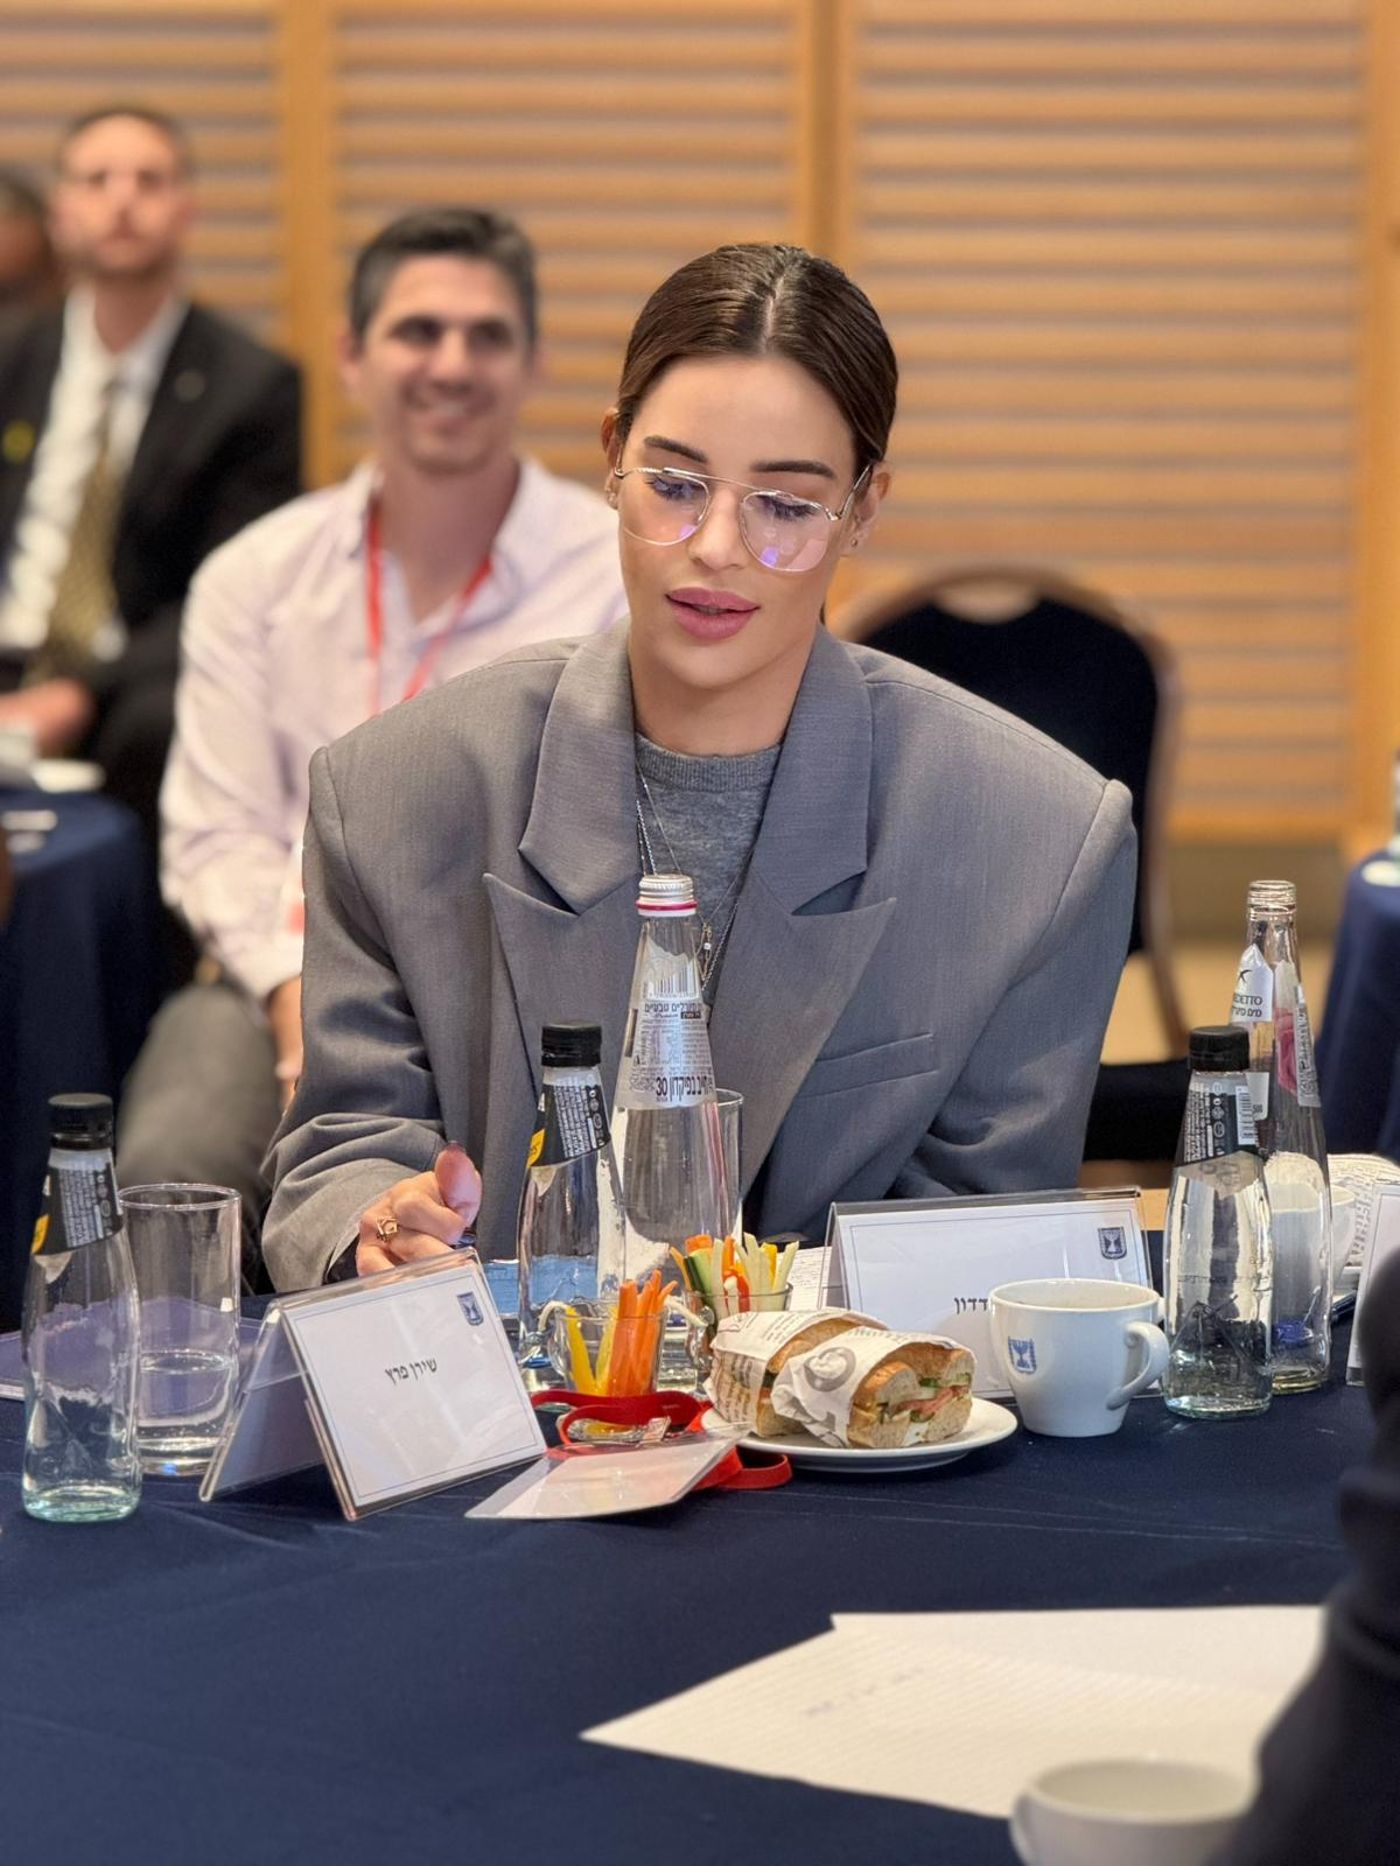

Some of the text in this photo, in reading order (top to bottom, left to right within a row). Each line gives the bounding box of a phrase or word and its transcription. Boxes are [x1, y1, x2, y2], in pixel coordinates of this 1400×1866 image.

[656, 1076, 668, 1096] 30
[385, 1357, 438, 1386] שירן פרץ
